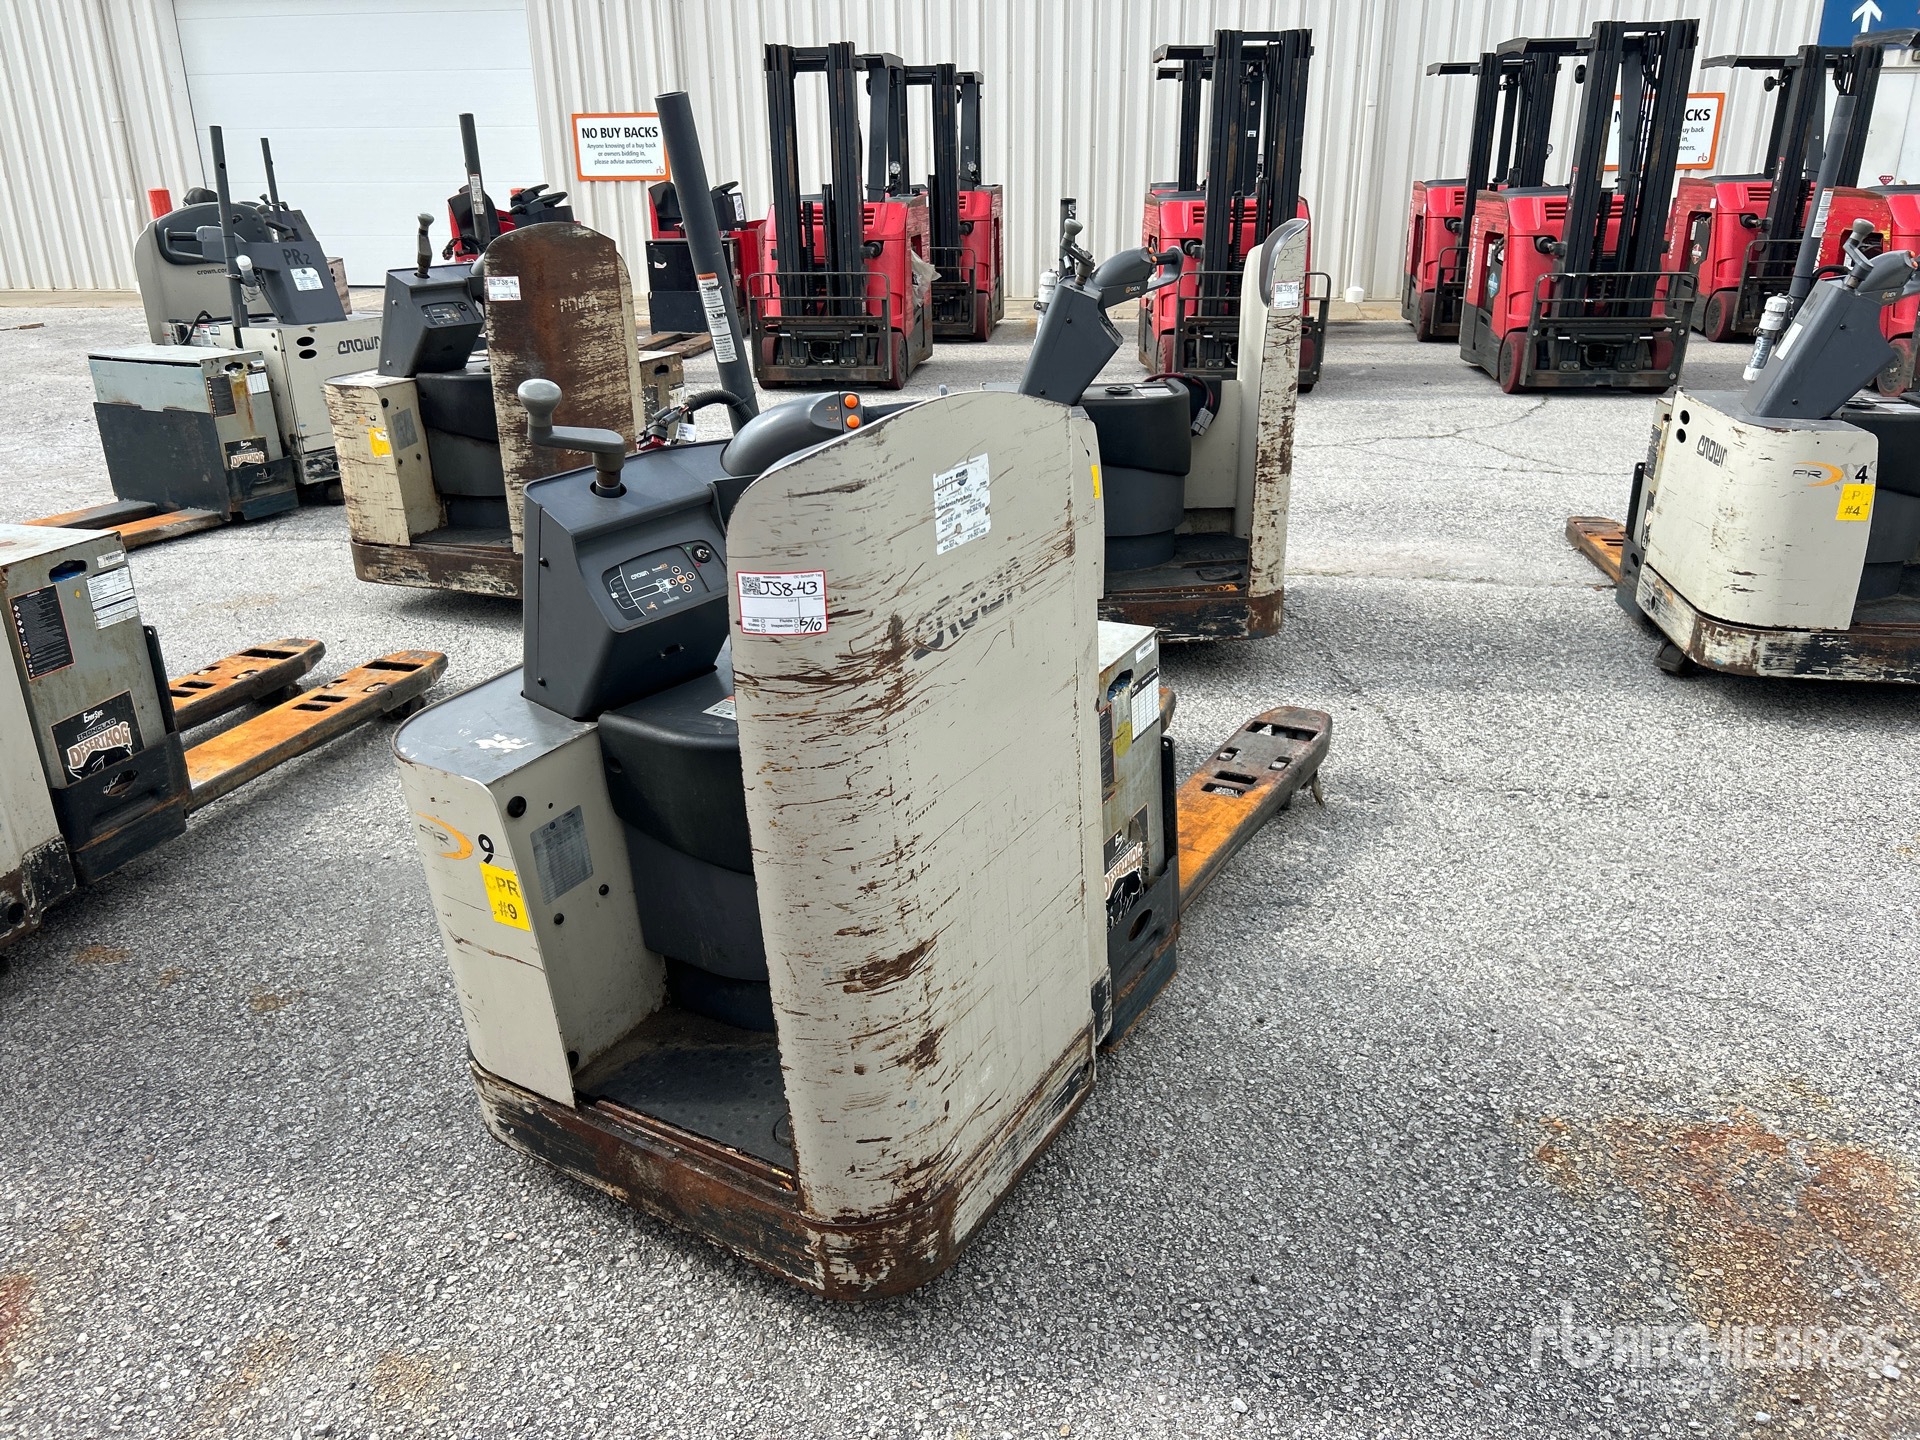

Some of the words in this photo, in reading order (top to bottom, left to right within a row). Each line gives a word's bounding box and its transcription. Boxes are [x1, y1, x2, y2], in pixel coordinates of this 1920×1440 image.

[582, 127, 598, 138] NO
[600, 127, 621, 138] BUY
[624, 126, 659, 138] BACKS
[605, 142, 625, 150] knowing
[636, 142, 645, 150] buy
[622, 150, 639, 158] bidding
[1697, 152, 1708, 162] rb
[656, 166, 664, 174] rb
[282, 248, 304, 266] PR
[305, 253, 312, 265] 2
[1792, 469, 1822, 479] PR
[1855, 465, 1868, 483] 4
[1844, 504, 1861, 516] #4
[760, 581, 818, 596] JS8-43
[67, 721, 132, 769] DESERTHOG
[478, 834, 495, 864] 9
[484, 874, 520, 897] CPR
[498, 901, 518, 920] #9
